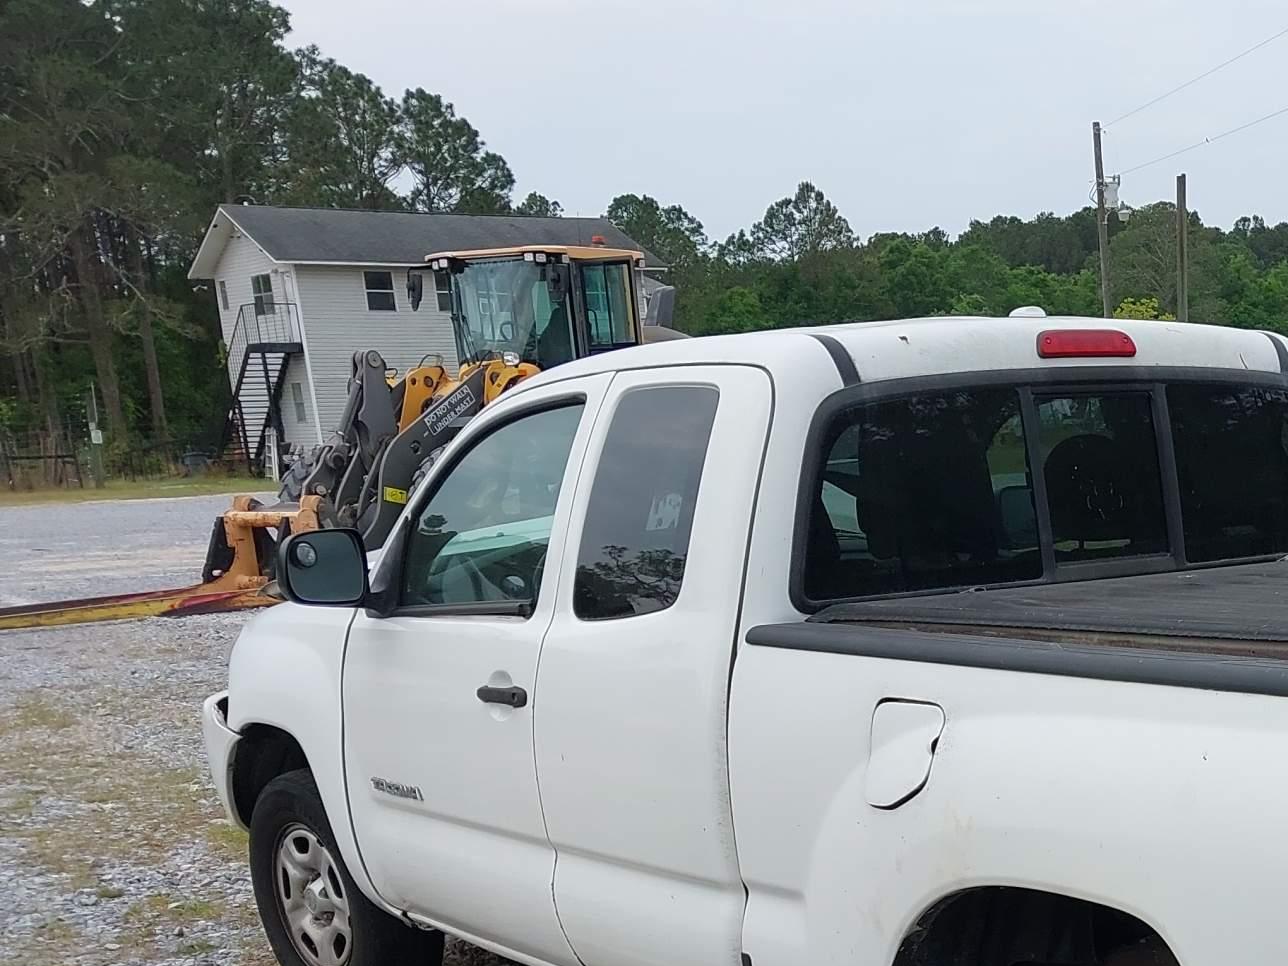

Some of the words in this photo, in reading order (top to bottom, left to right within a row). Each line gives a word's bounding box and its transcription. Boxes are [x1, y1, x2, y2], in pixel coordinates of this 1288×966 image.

[425, 415, 436, 425] DO
[450, 387, 469, 404] WALK
[434, 411, 455, 430] UNDER
[455, 397, 471, 414] MAST
